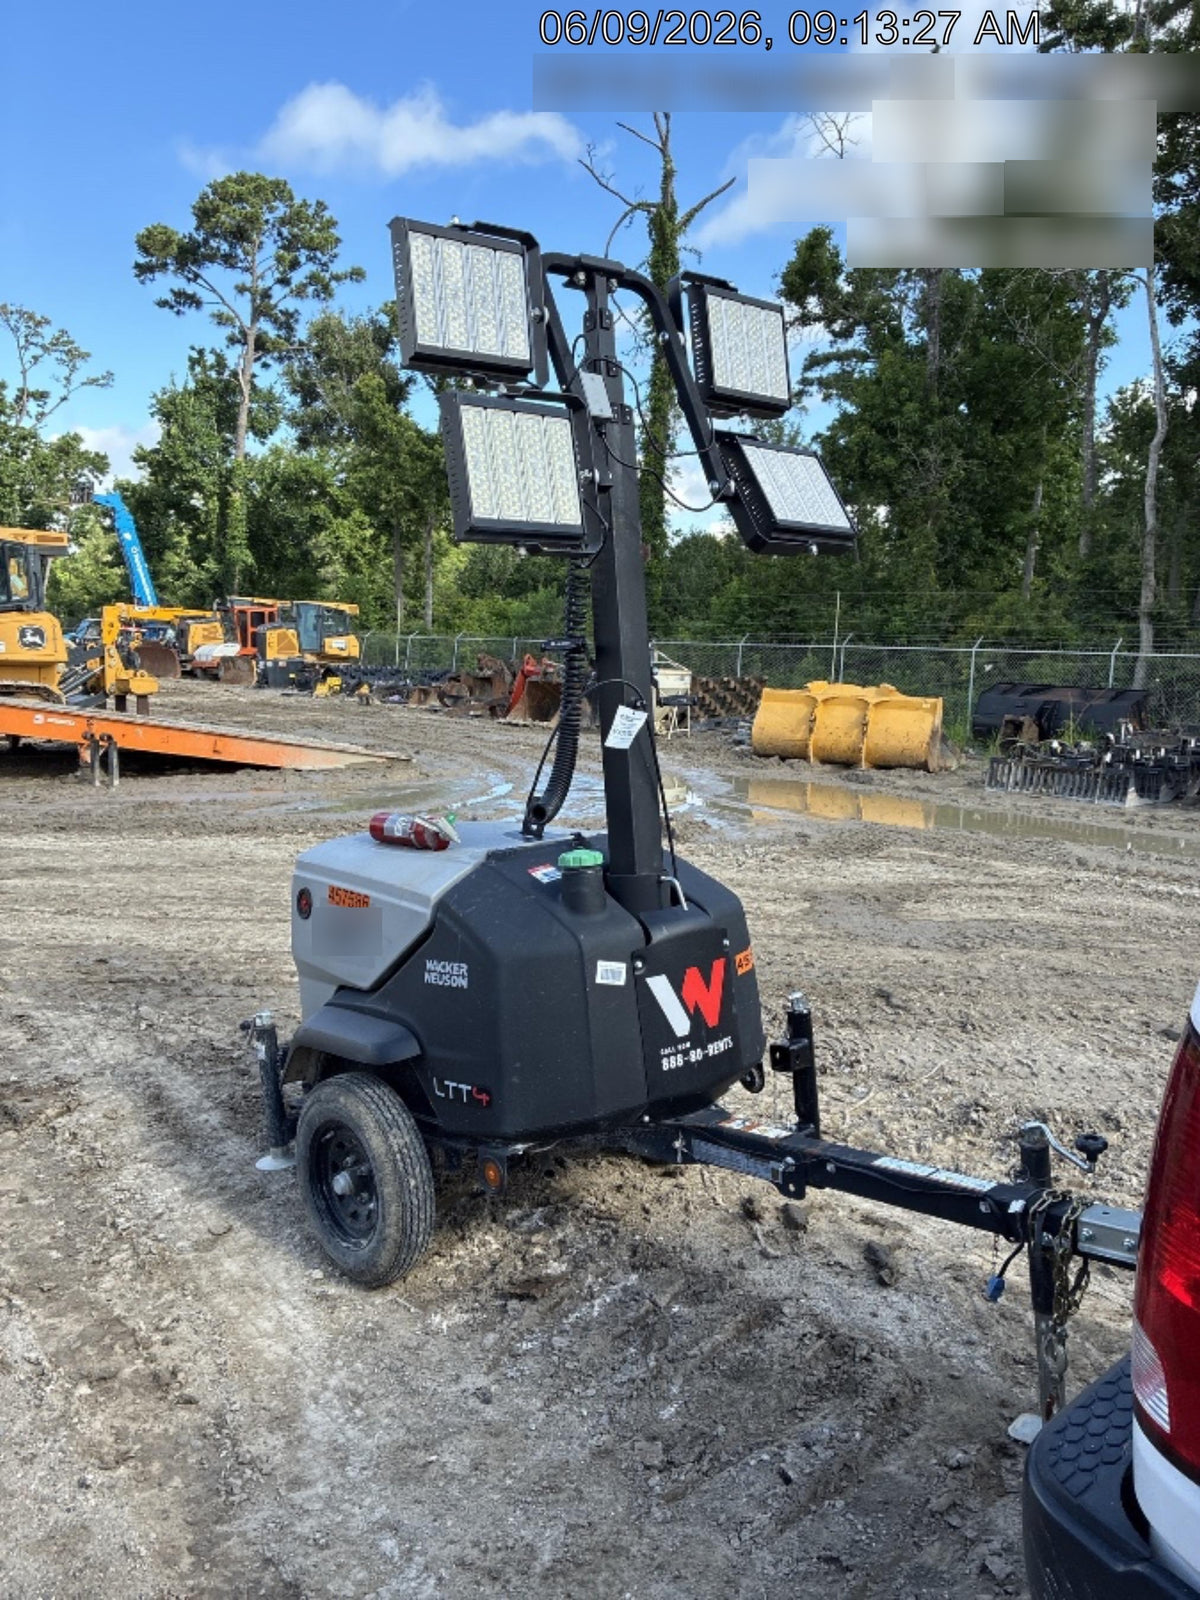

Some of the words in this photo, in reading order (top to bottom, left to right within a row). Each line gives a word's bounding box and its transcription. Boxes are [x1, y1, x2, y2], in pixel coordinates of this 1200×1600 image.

[425, 959, 468, 977] WACKER
[424, 971, 468, 989] NEUSON
[433, 1076, 490, 1107] LTT4
